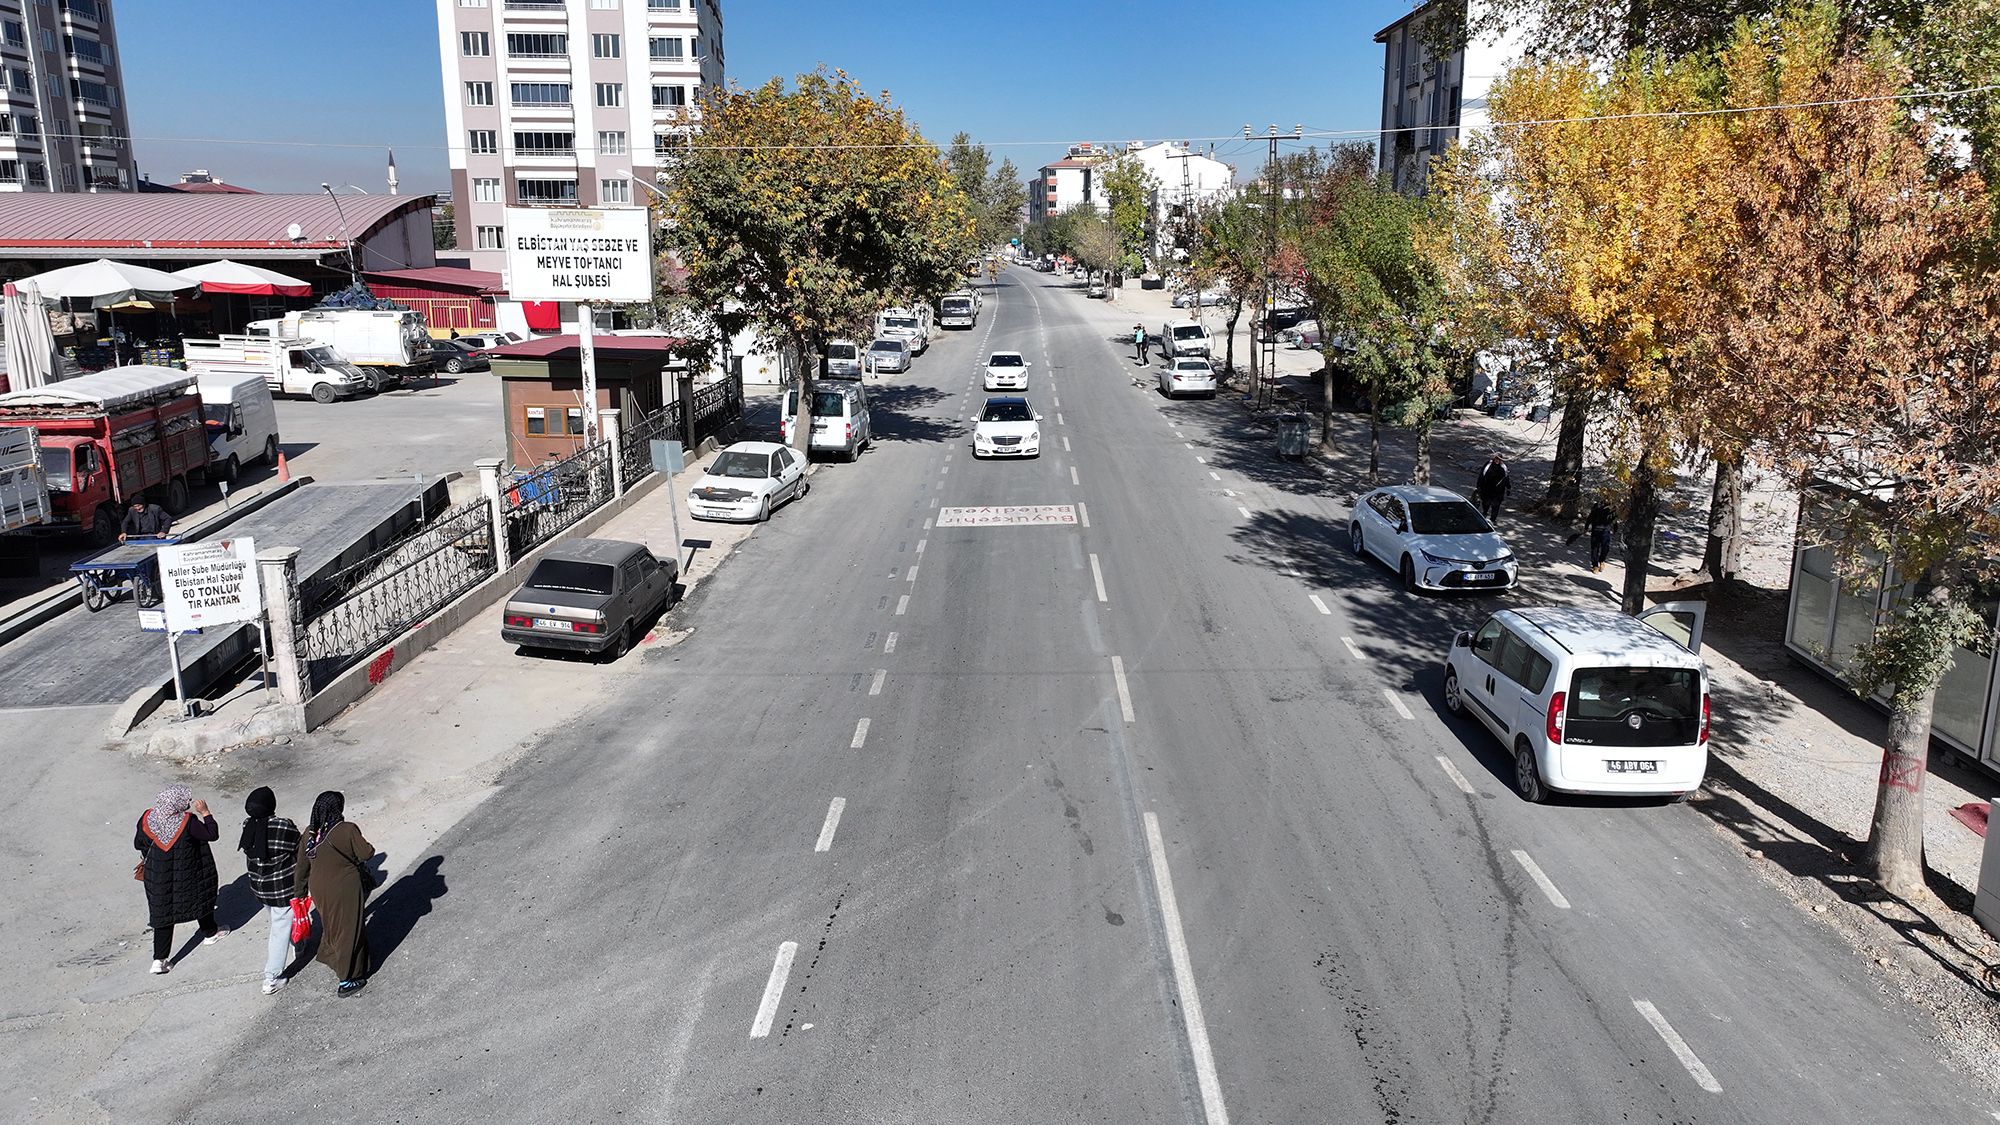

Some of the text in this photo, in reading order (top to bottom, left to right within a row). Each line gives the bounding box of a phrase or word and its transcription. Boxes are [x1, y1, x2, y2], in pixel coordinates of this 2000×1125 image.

[518, 234, 638, 253] ELBİSTAN YAŞ SEBZE VE
[537, 256, 622, 269] MEYVE TOPTANCI
[552, 272, 611, 288] HAL ŞUBESİ
[168, 567, 190, 578] Haller
[210, 560, 247, 571] Müdürlüğü
[175, 571, 244, 588] Elbistan Hal Şubesi
[182, 583, 242, 599] 60 TONLUK
[188, 599, 203, 609] TIR
[1611, 761, 1621, 771] 46
[1640, 761, 1655, 771] 064
